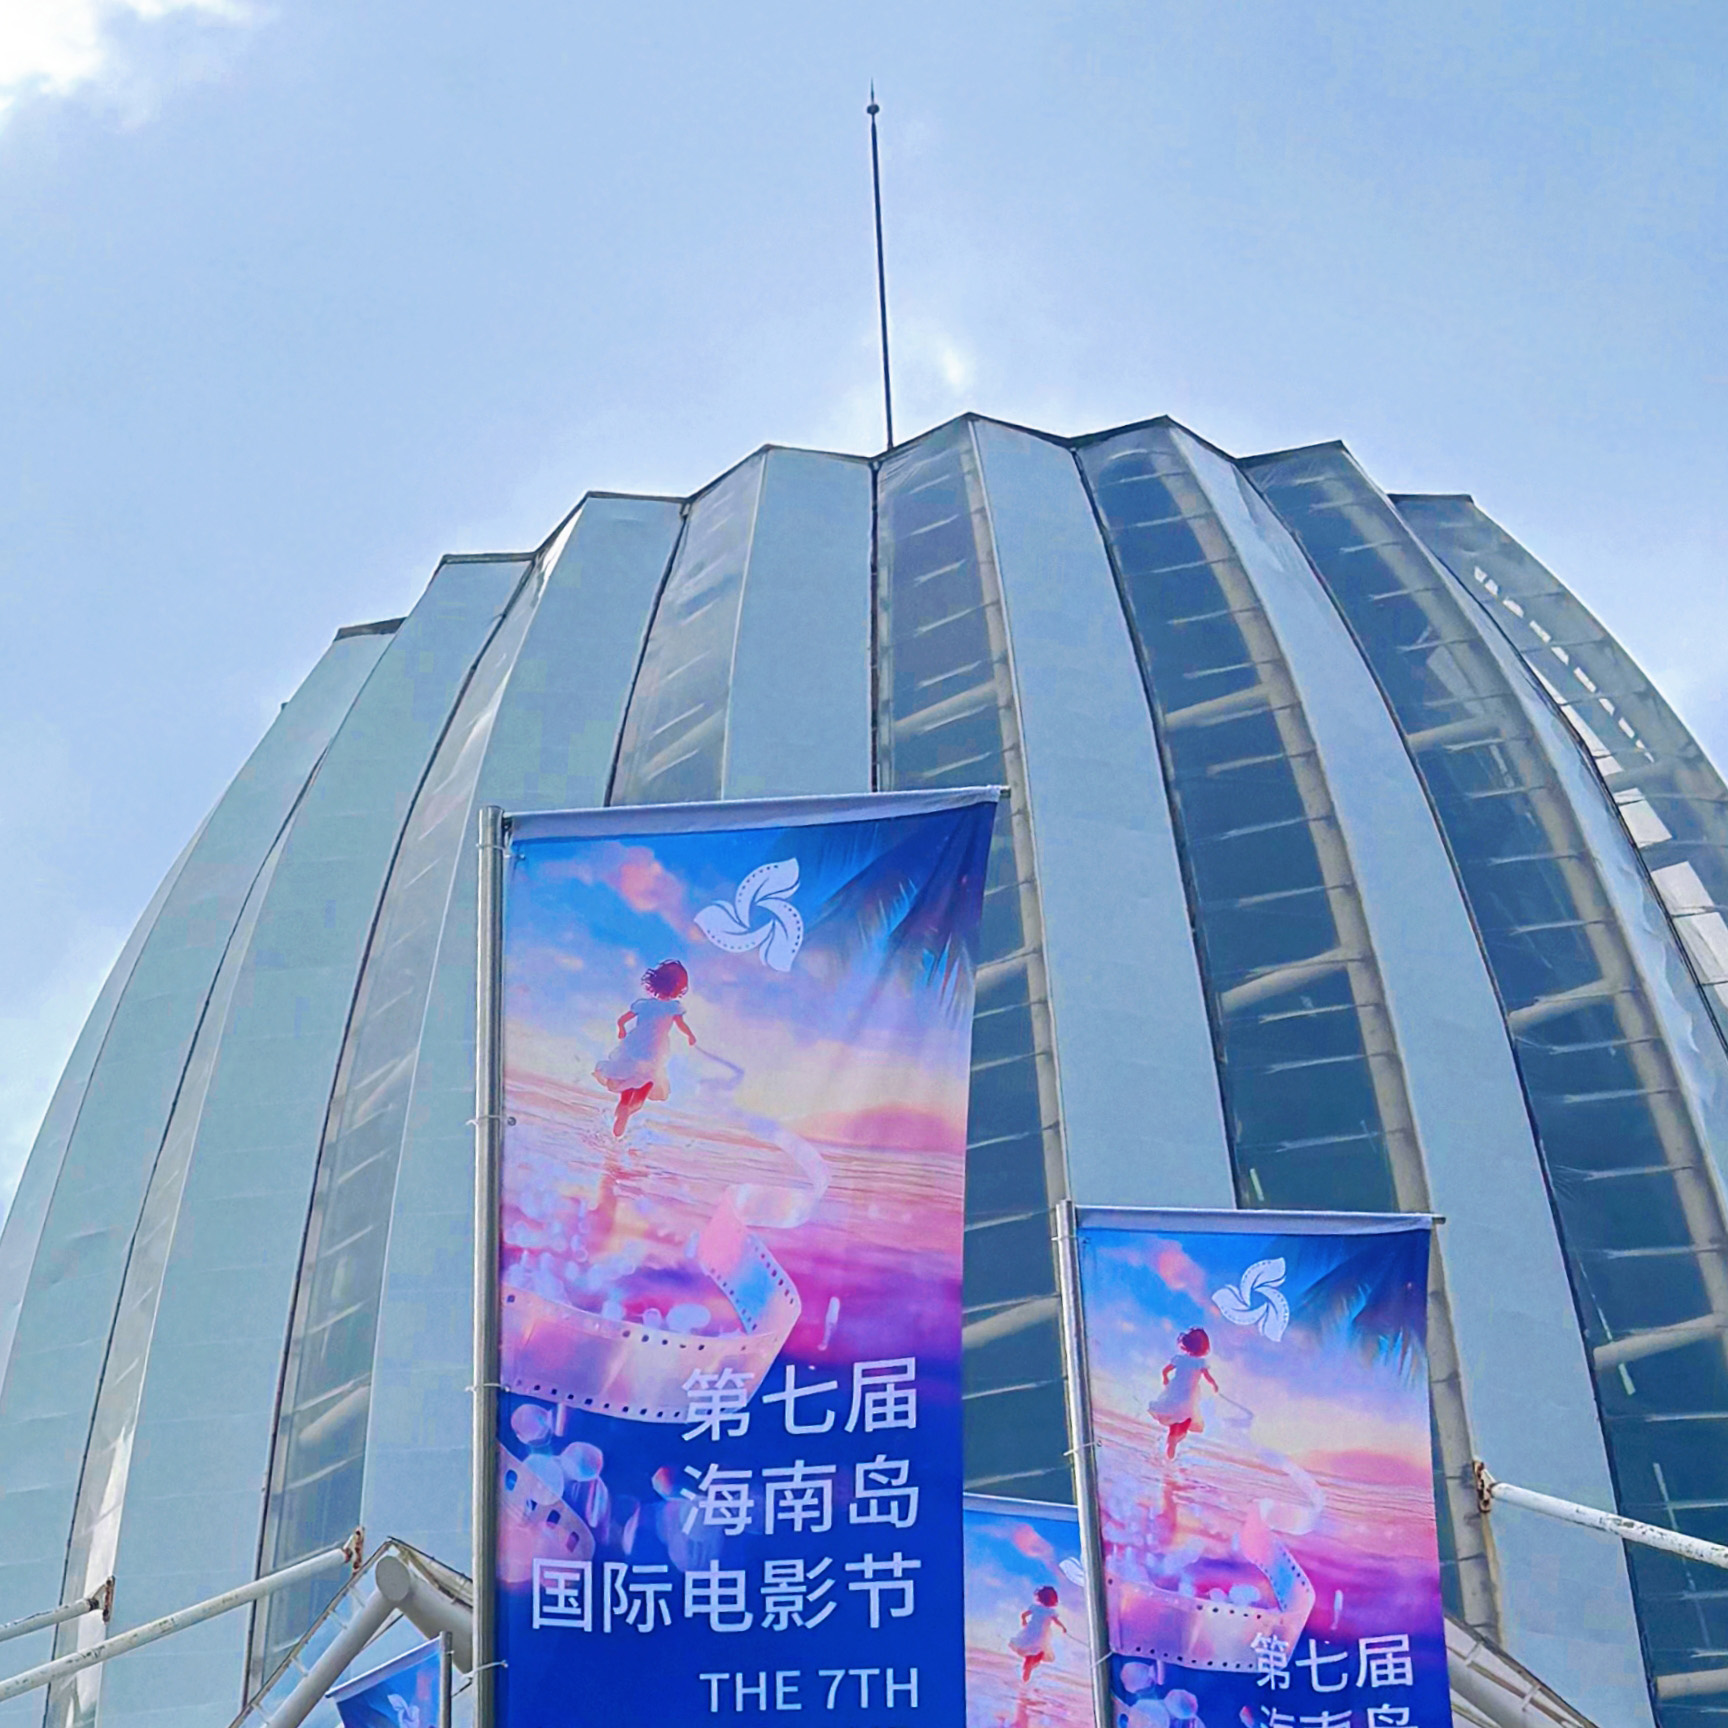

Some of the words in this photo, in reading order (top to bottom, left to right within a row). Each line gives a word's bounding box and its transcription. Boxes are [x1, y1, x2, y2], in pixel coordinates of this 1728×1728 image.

[681, 1356, 918, 1442] 第七届
[679, 1454, 920, 1537] 海南岛
[530, 1550, 922, 1634] 国际电影节
[699, 1670, 803, 1713] THE
[817, 1667, 919, 1709] 7TH
[1250, 1632, 1415, 1694] 第七届
